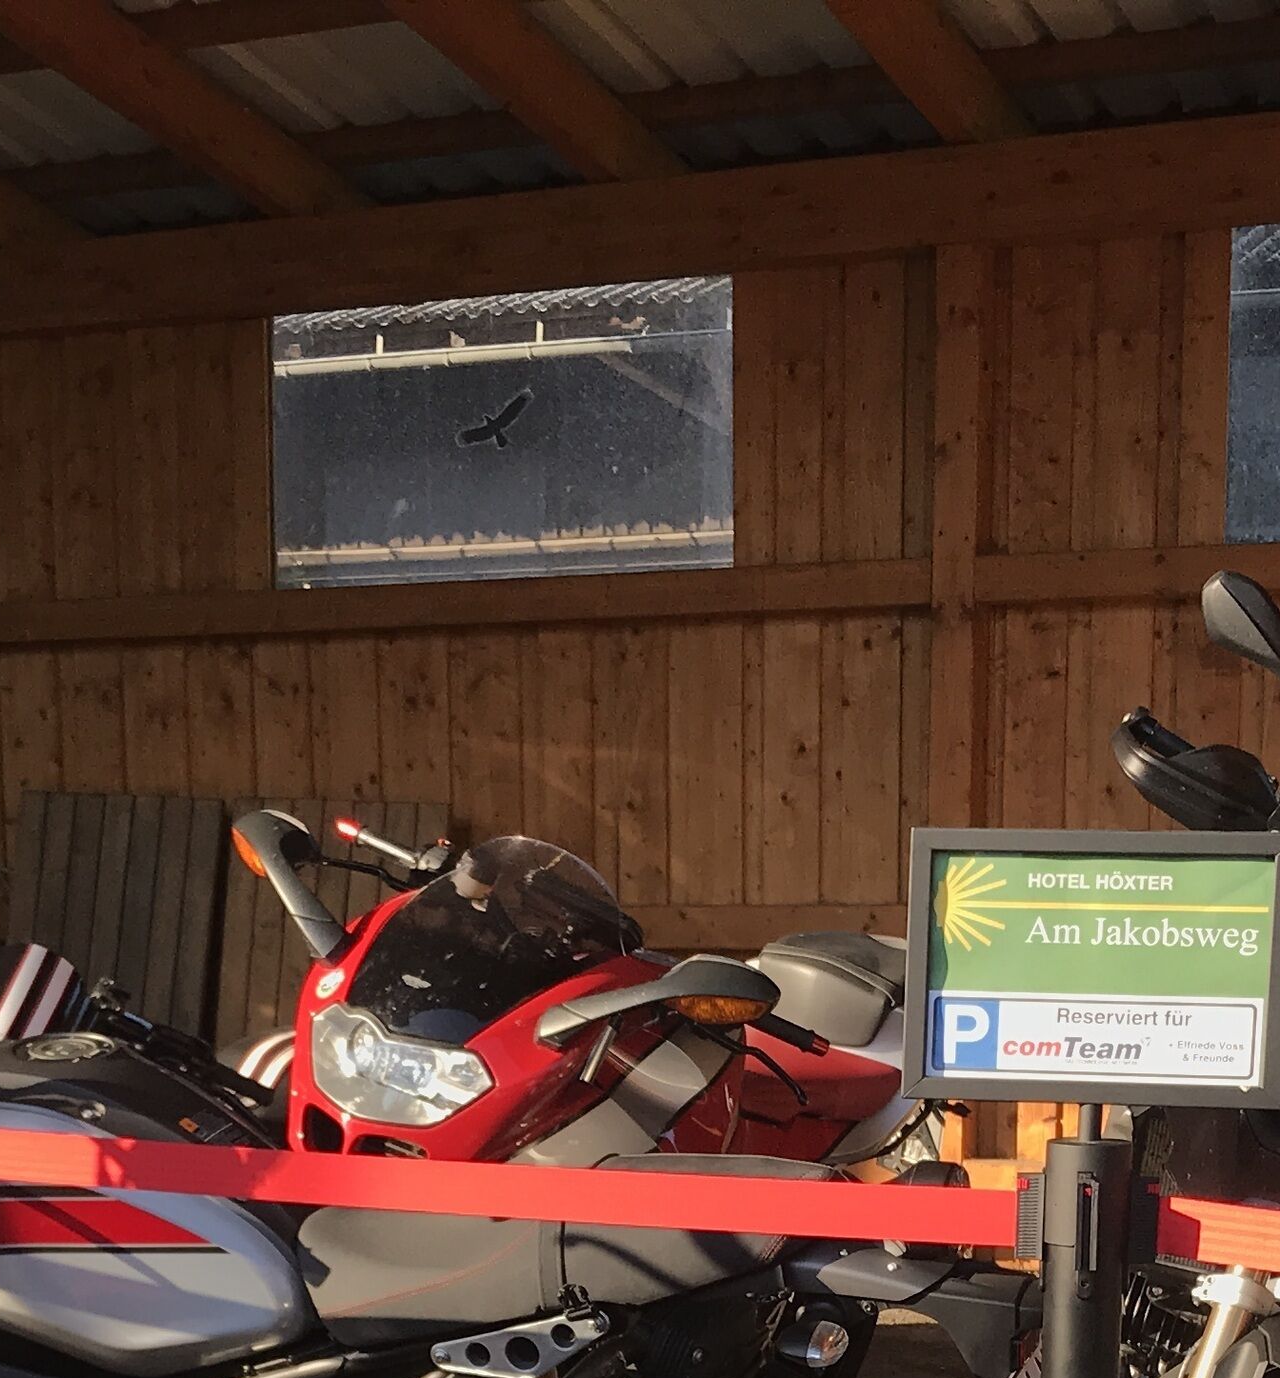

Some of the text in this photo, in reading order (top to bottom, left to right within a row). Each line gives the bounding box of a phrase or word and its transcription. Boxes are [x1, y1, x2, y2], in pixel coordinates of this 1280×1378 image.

[1027, 870, 1174, 892] HOTEL HÖXTER
[1024, 915, 1259, 956] Am Jakobsweg
[1056, 1006, 1193, 1027] Reserviert für
[942, 1003, 990, 1064] P
[1002, 1036, 1143, 1060] comTeam
[1192, 1053, 1235, 1063] Freunde
